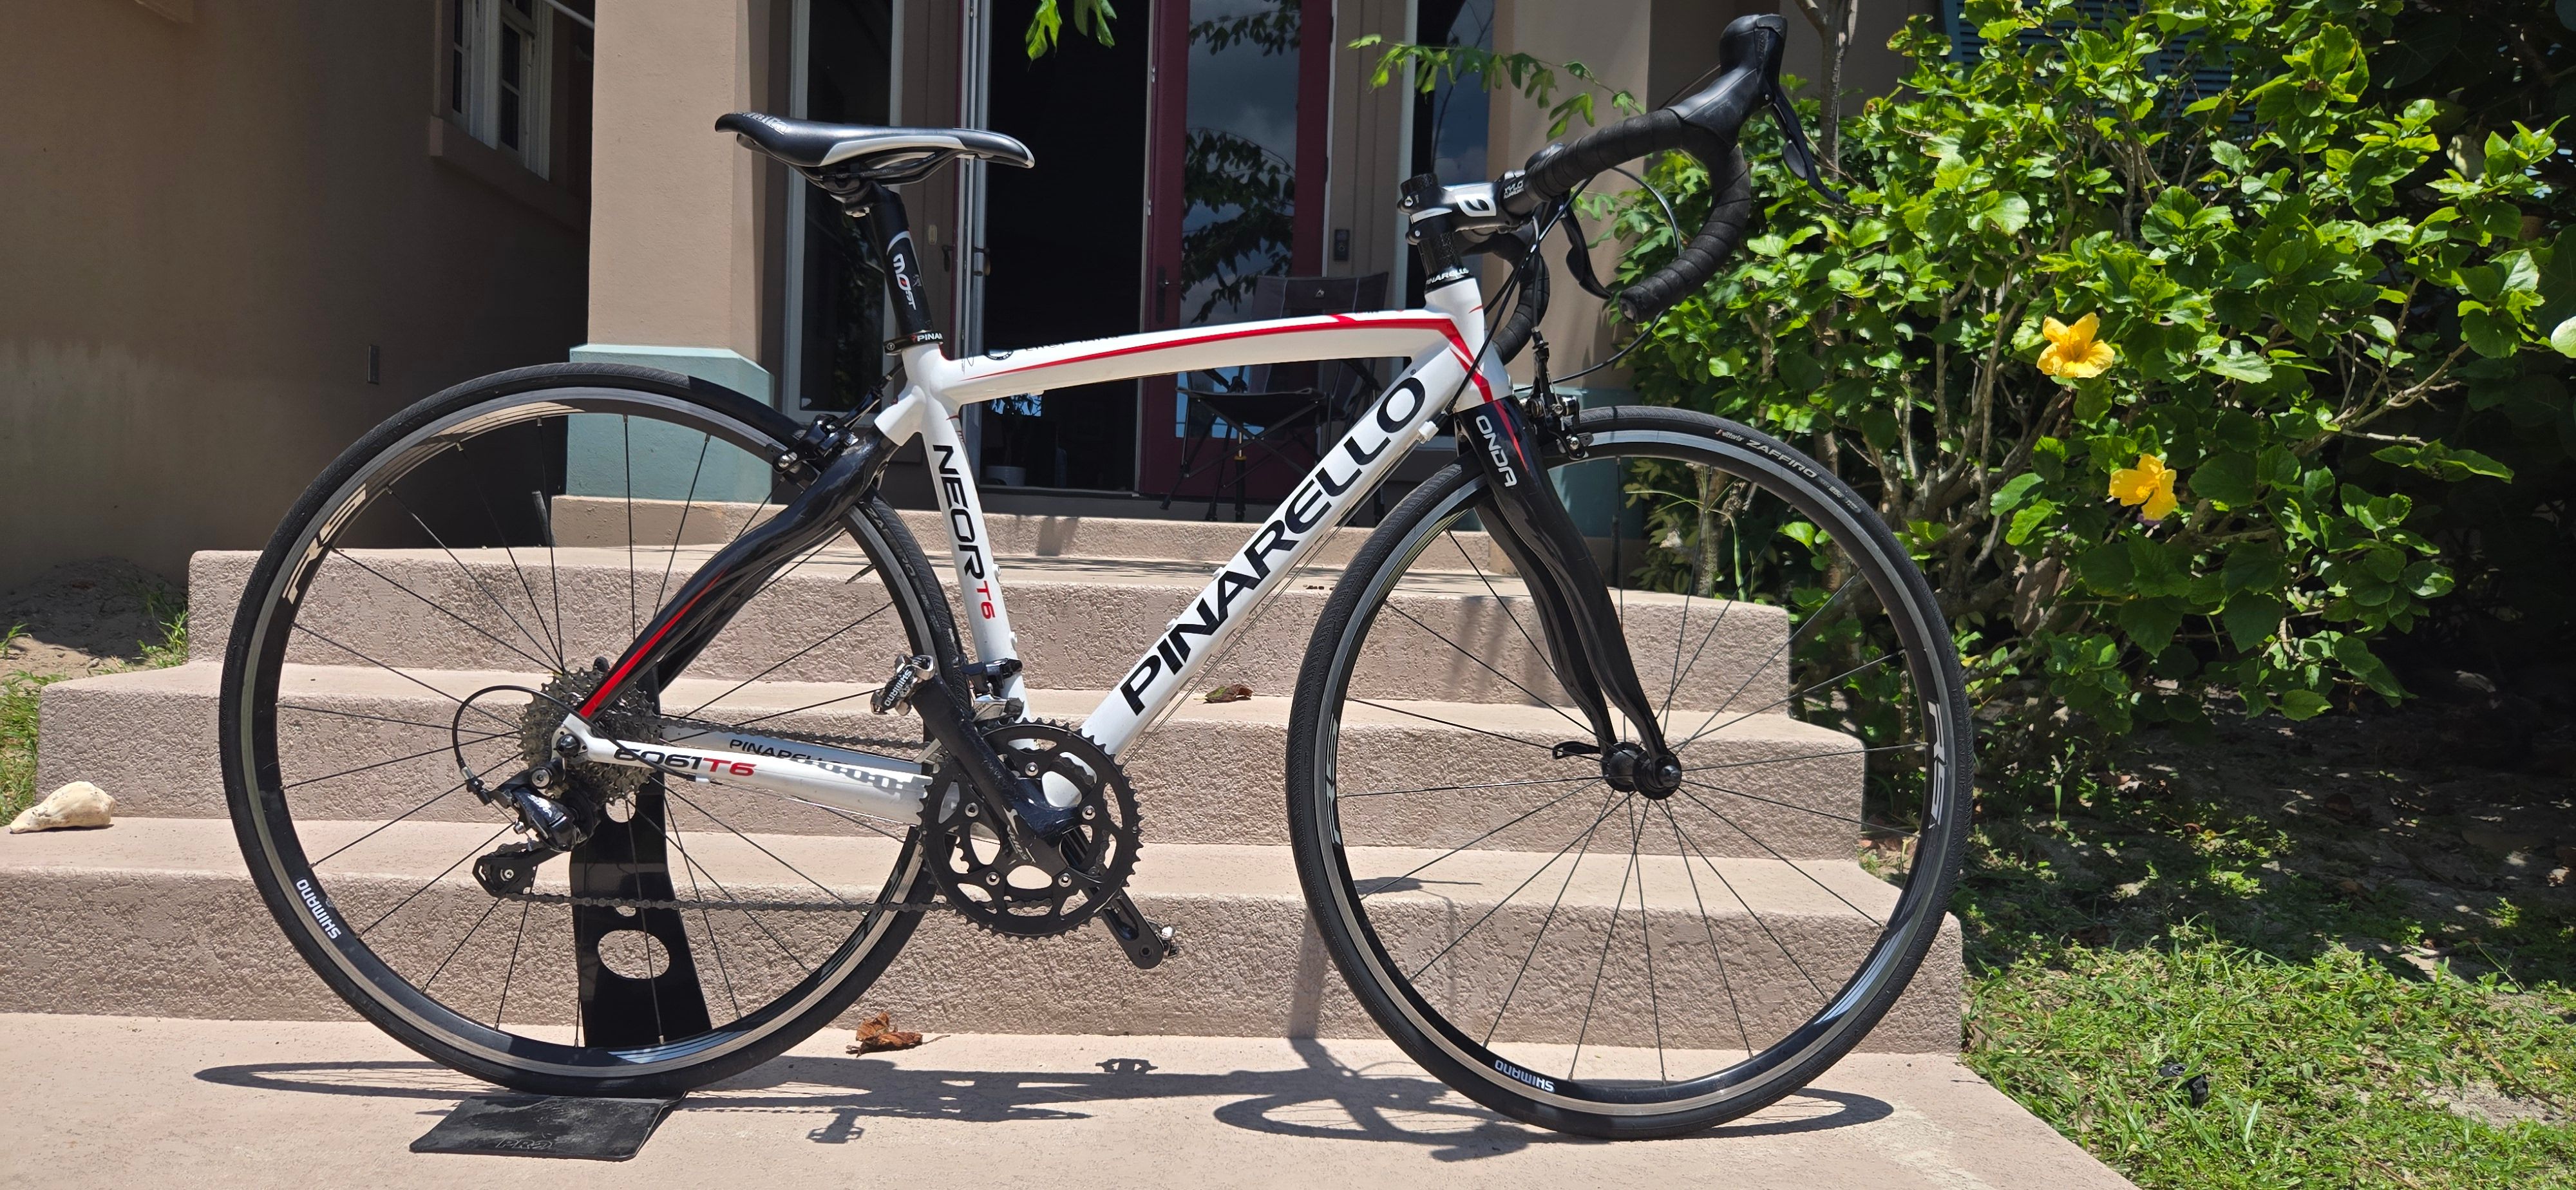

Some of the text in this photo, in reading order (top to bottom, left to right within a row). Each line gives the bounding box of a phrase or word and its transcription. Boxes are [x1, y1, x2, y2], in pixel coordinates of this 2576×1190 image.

[893, 253, 916, 310] MOST
[1476, 415, 1517, 487] ONDA
[1747, 439, 1818, 479] ZAFFIRO
[1120, 377, 1426, 715] PINARELLO
[884, 669, 913, 706] SHIMANO
[296, 879, 342, 939] SHIMANO
[1495, 1059, 1555, 1093] SHIMANO
